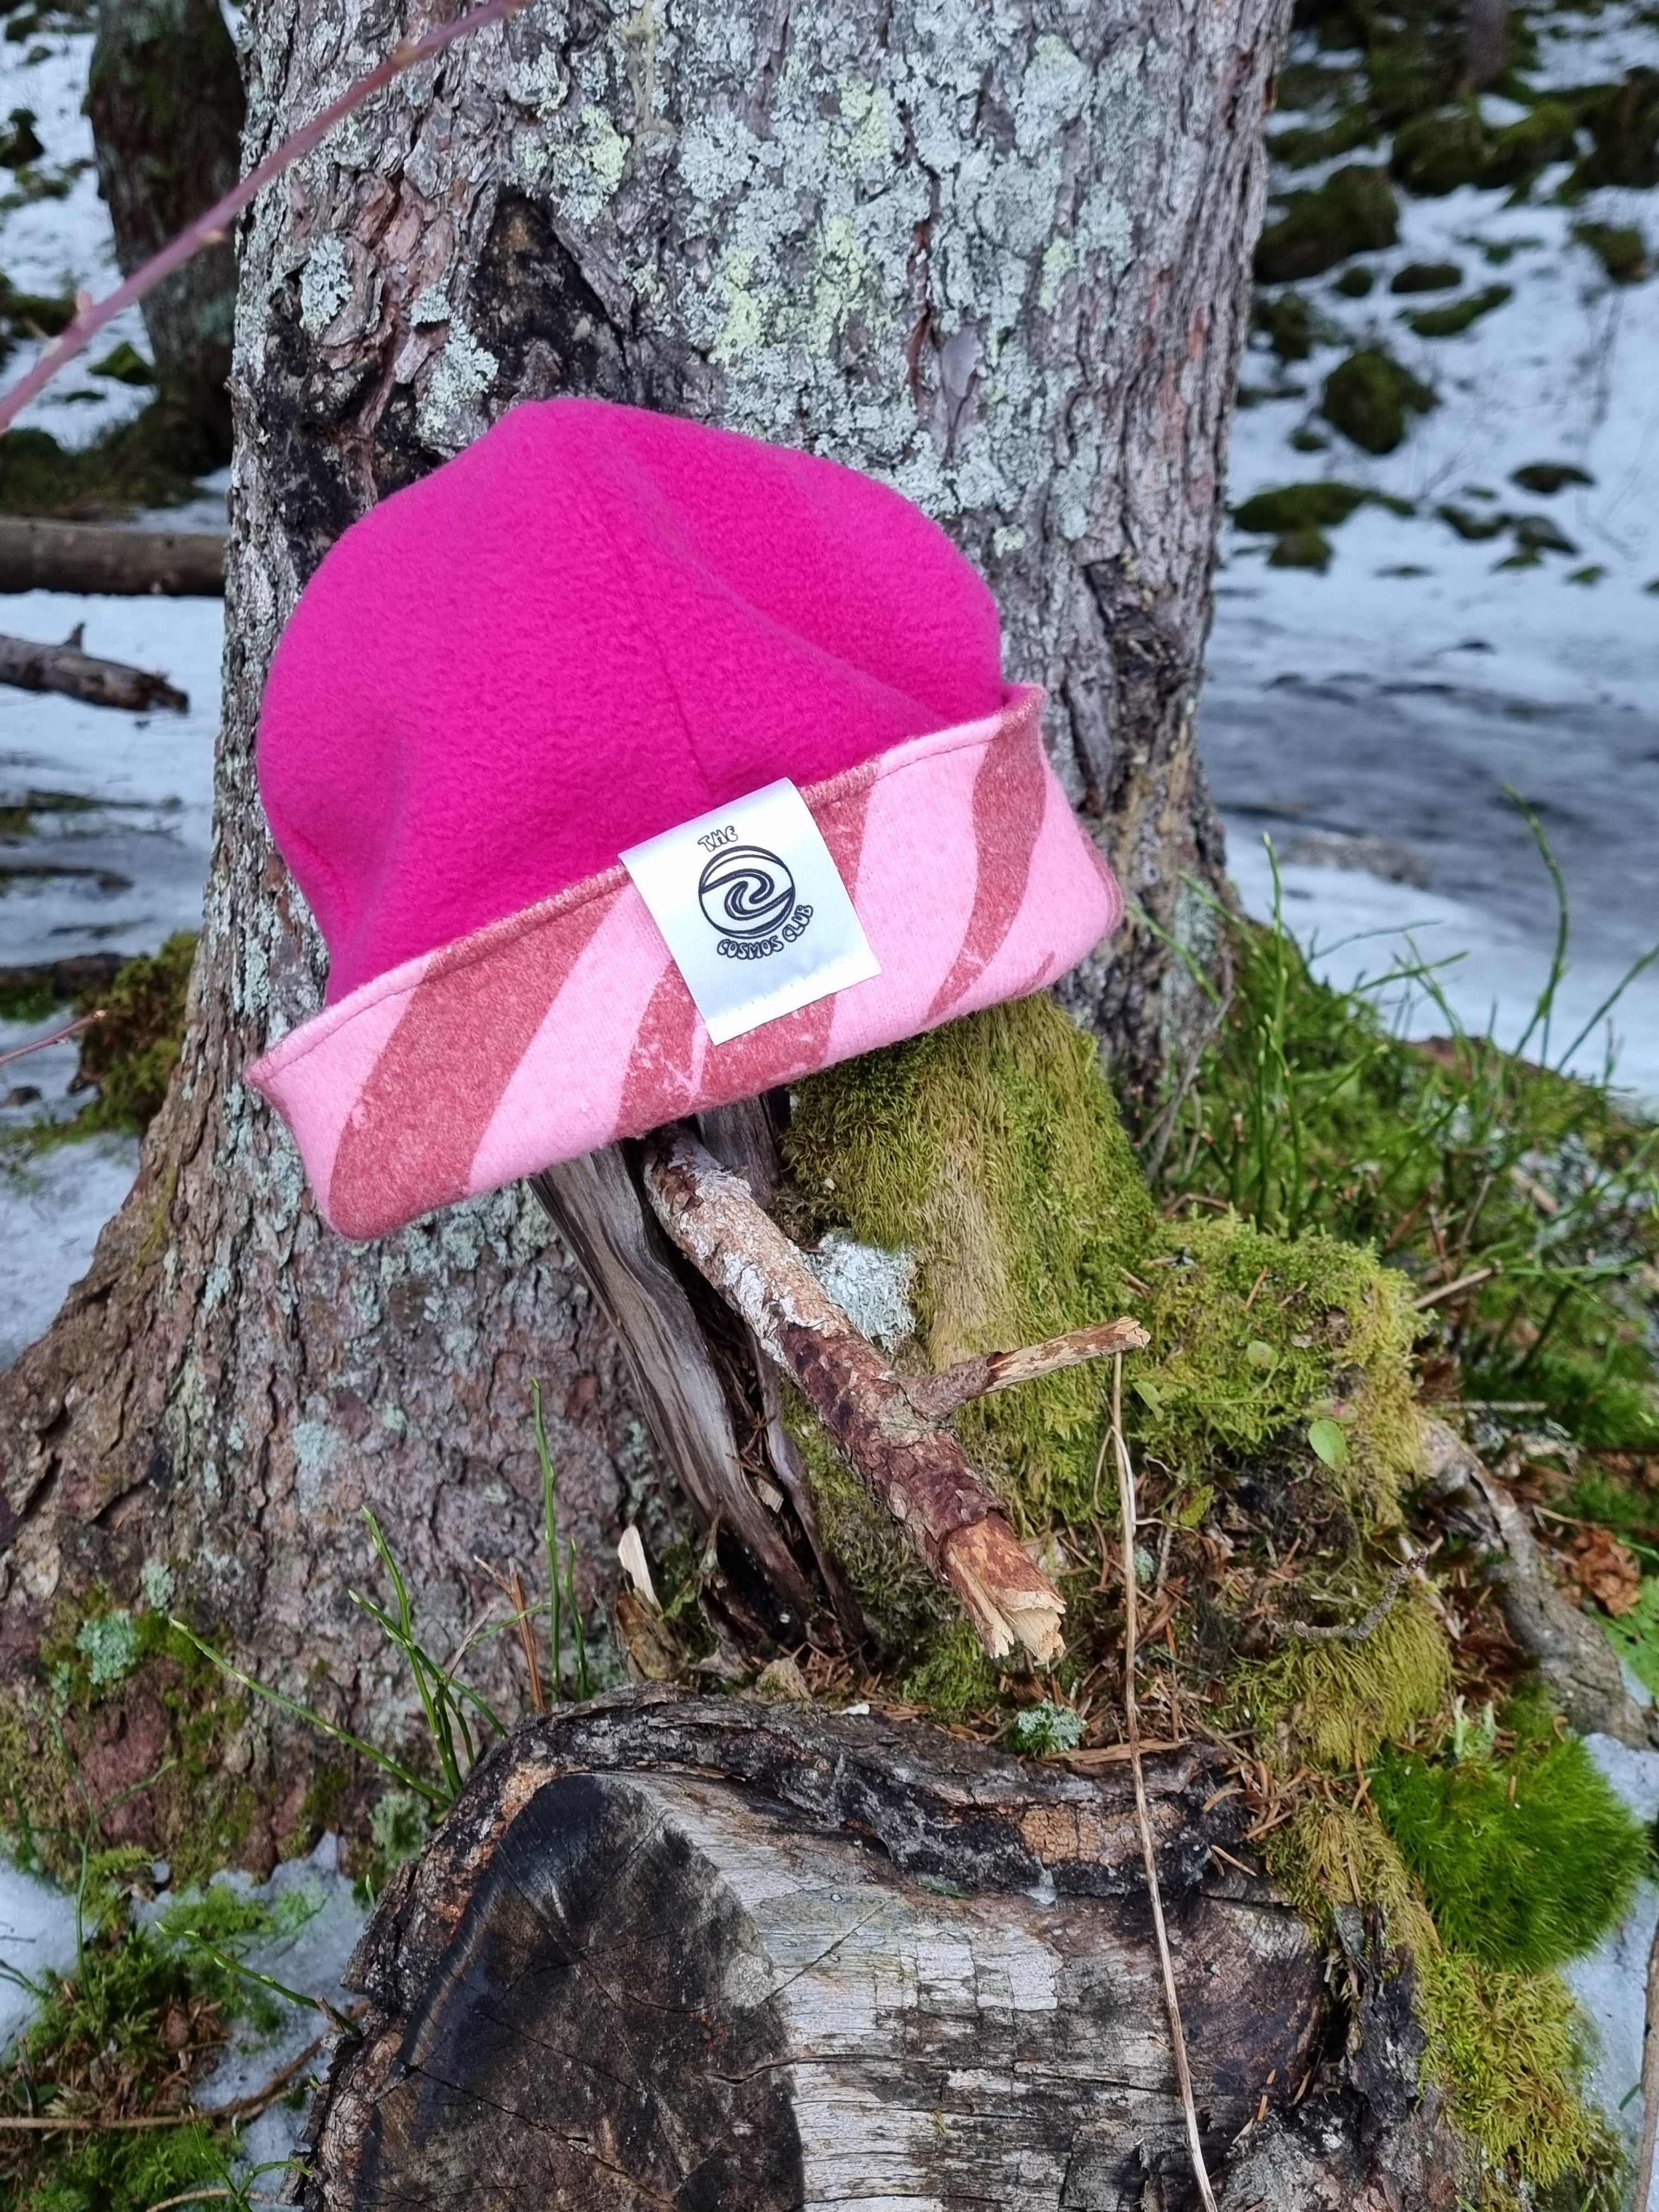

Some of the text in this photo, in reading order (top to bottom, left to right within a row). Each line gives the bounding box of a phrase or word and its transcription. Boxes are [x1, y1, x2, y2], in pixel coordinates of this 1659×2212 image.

[697, 825, 738, 852] THE
[717, 905, 814, 960] COSMOS CLUB
